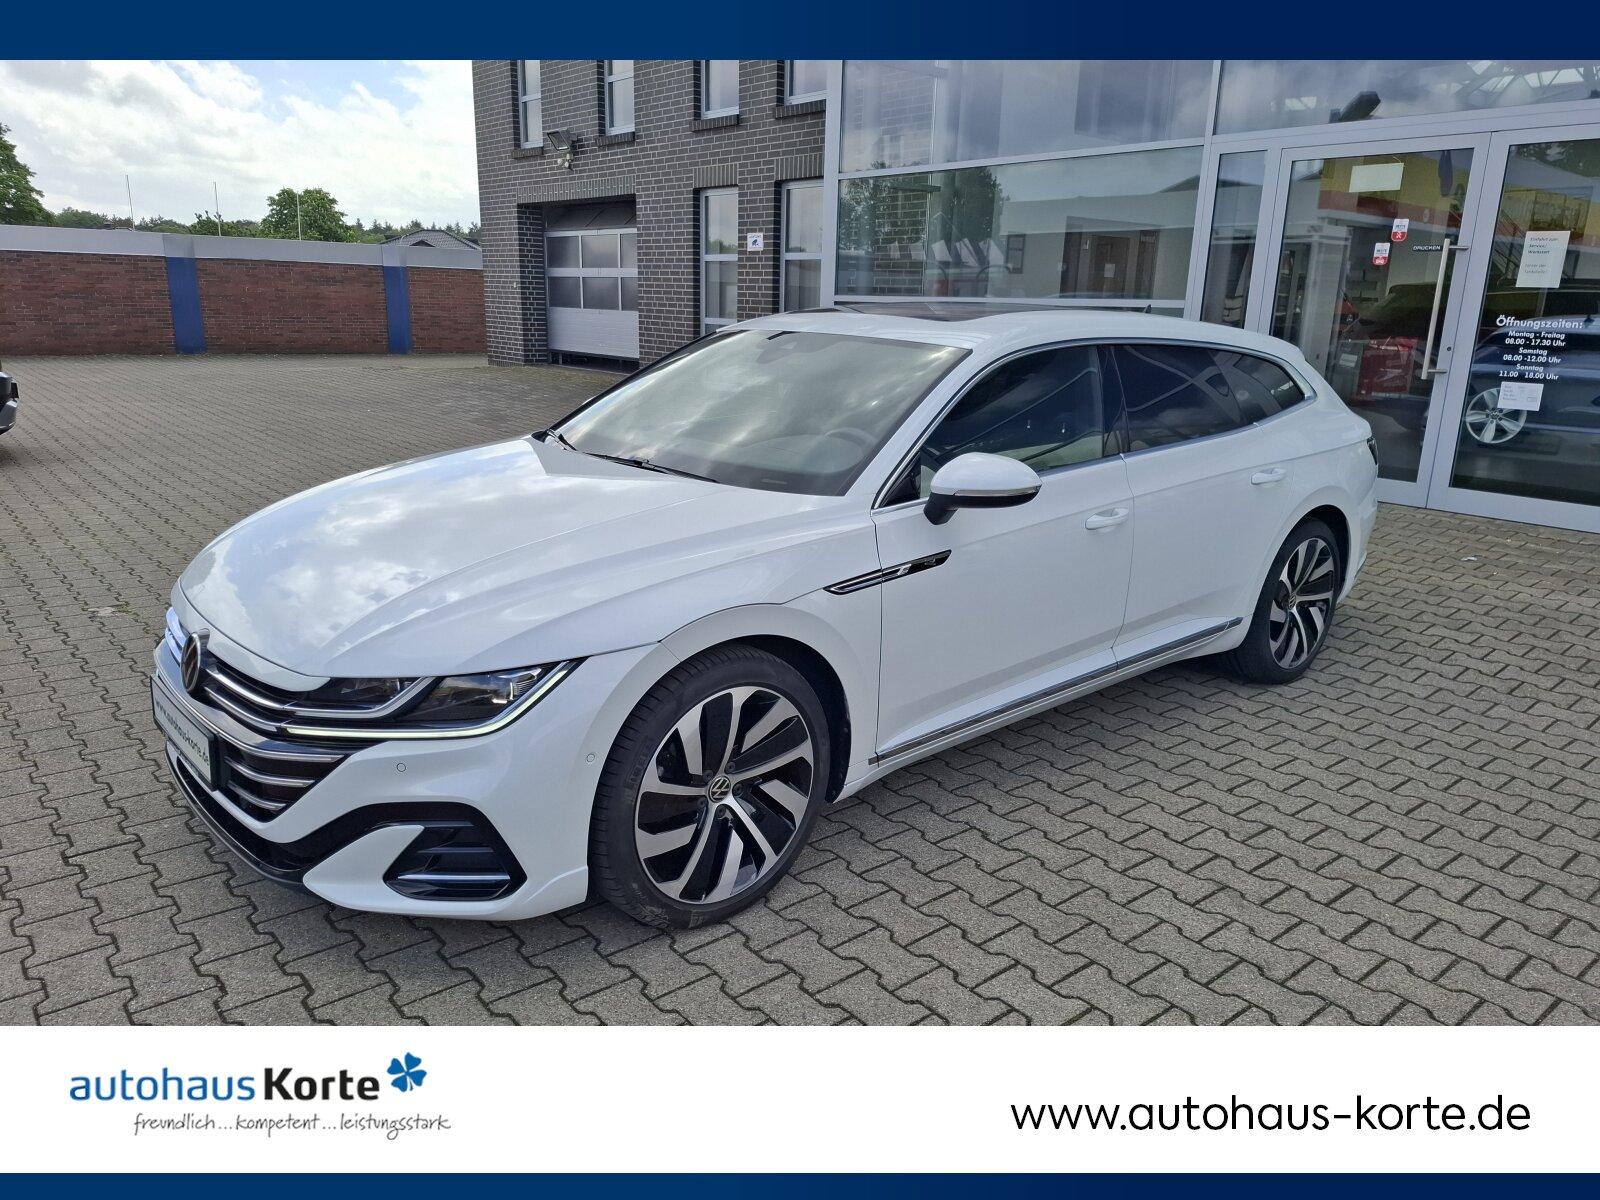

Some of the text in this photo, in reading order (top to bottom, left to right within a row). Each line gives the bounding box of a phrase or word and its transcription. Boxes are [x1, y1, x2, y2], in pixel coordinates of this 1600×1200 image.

[1496, 315, 1583, 329] Öffnungszeiten:
[1508, 331, 1535, 339] Montag
[1540, 331, 1566, 340] Freitag
[1518, 347, 1548, 356] Samstag
[1516, 364, 1544, 373] Sonntag
[1499, 370, 1519, 378] 11.00
